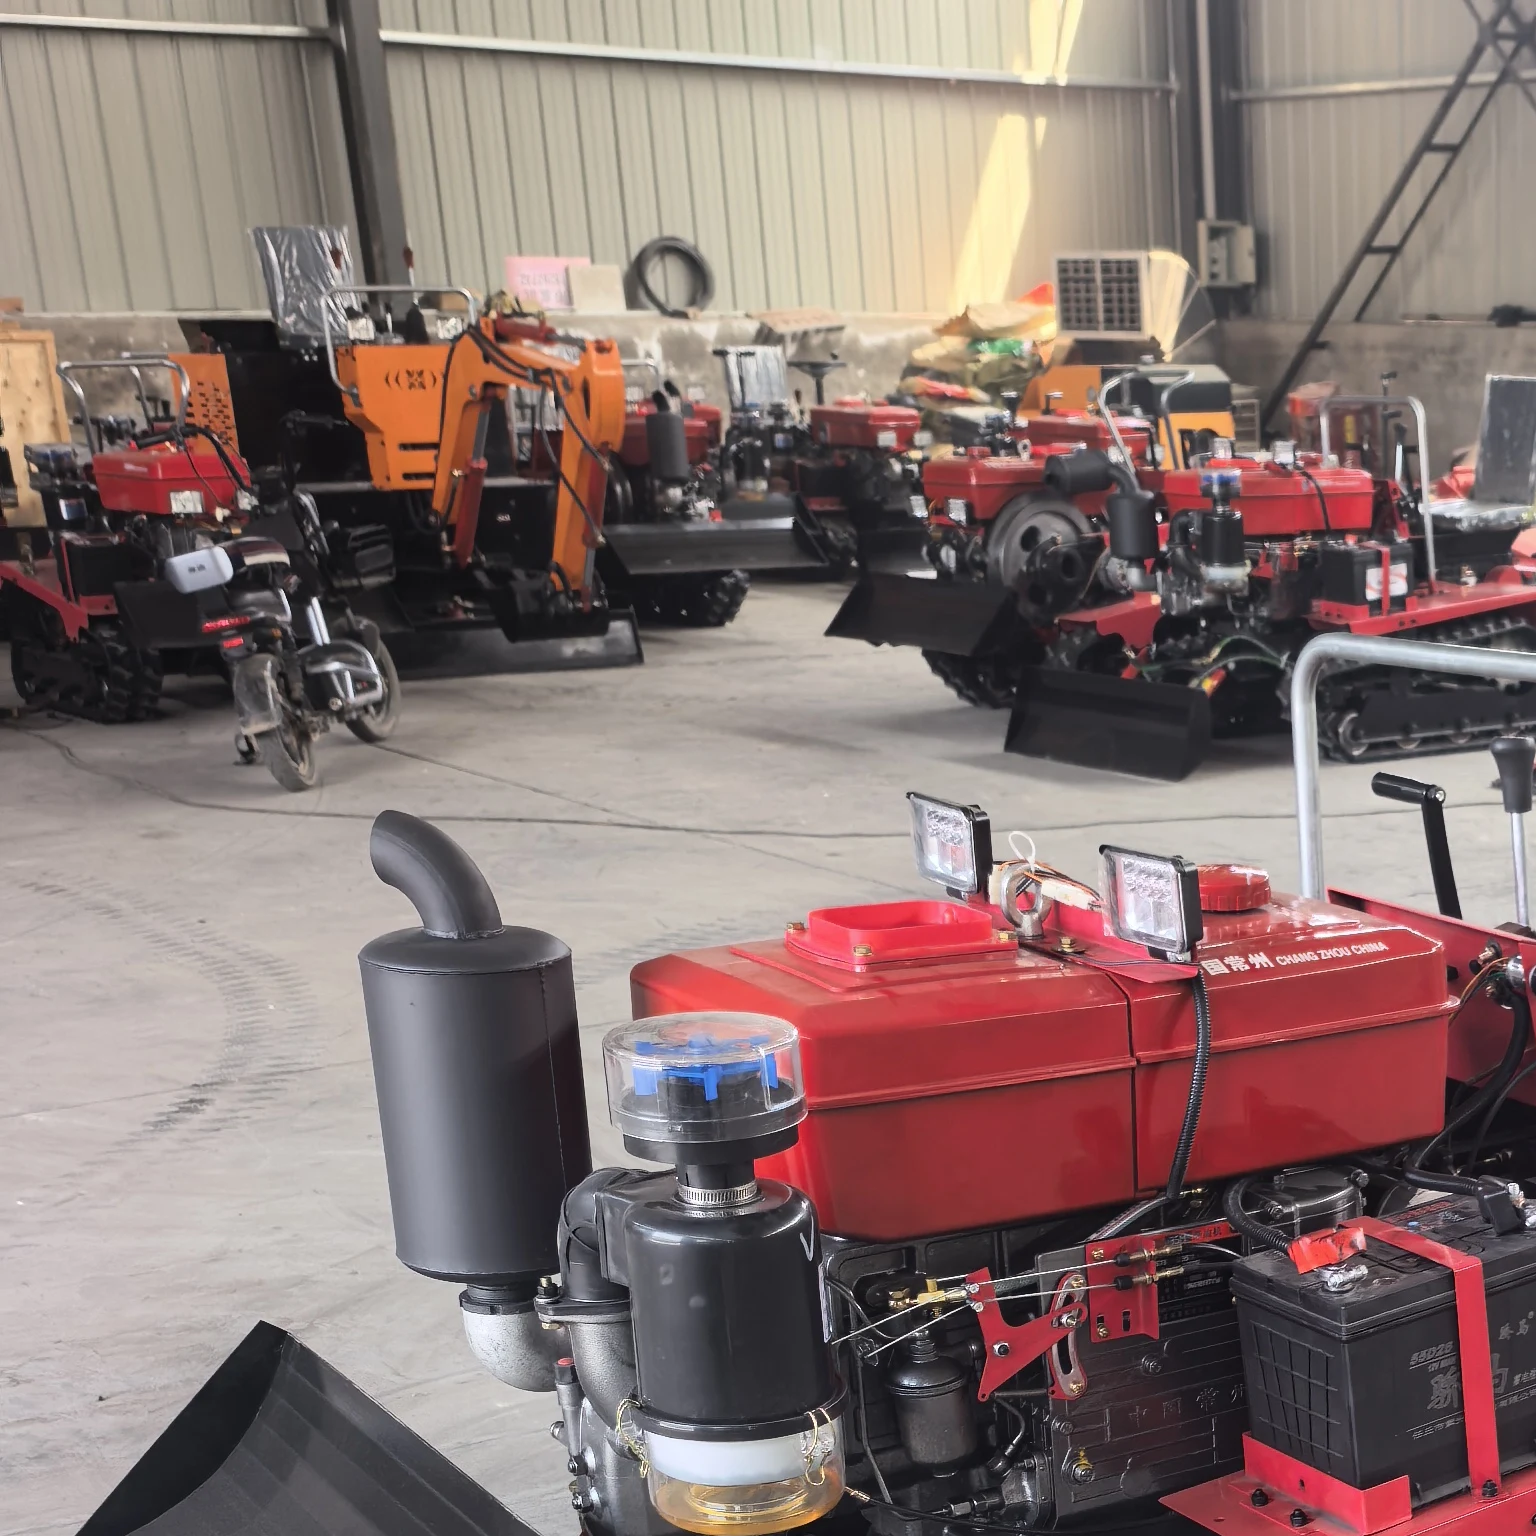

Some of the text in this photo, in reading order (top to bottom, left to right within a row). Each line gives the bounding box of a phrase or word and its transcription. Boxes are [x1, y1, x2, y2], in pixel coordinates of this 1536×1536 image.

[1275, 951, 1318, 966] CHANG
[1319, 946, 1350, 960] ZHOU
[1351, 941, 1389, 956] CHINA
